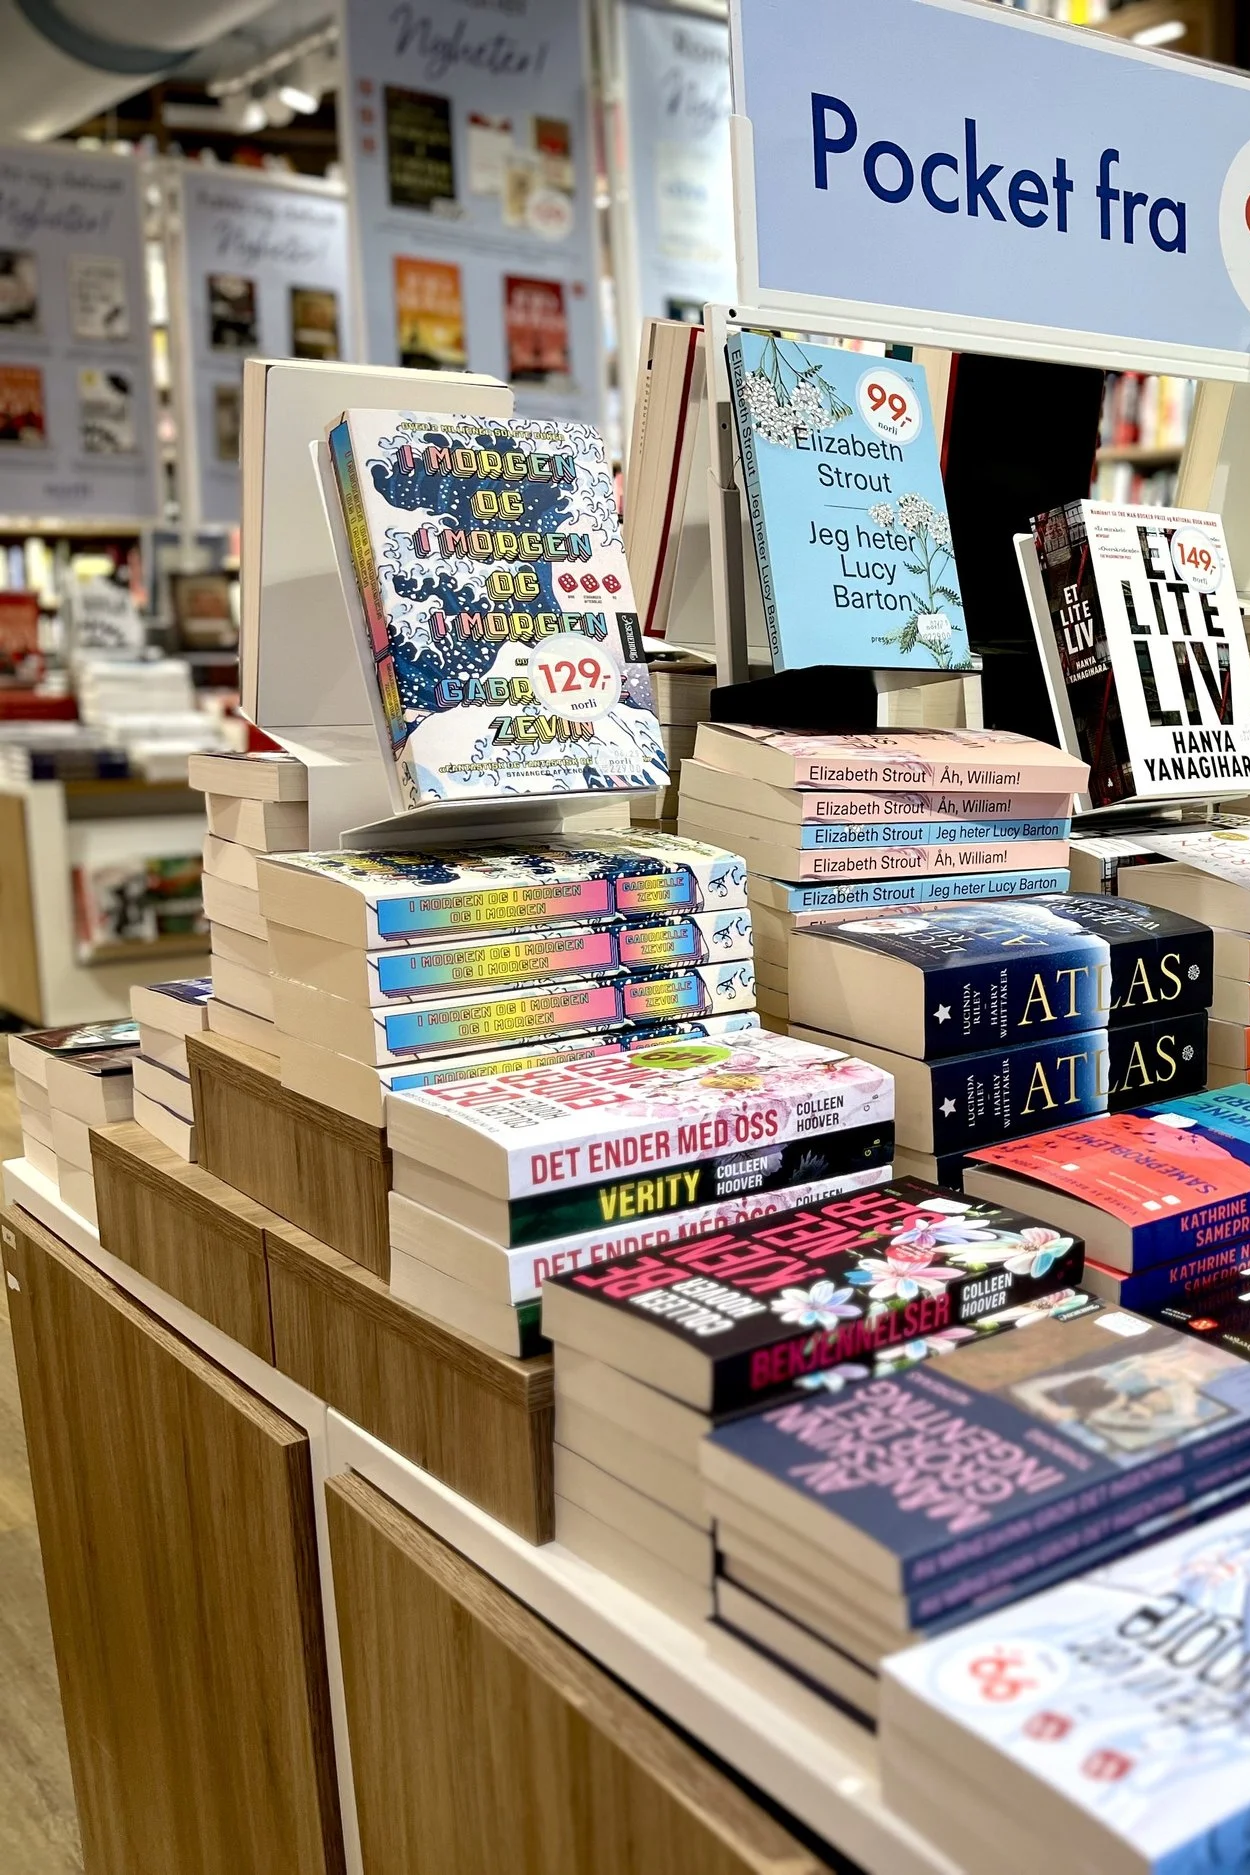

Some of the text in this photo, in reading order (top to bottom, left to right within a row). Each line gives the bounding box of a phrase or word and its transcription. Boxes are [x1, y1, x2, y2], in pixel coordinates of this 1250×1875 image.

[811, 93, 1073, 232] Pocket
[1096, 148, 1187, 254] fra
[868, 384, 912, 428] 99,-
[878, 421, 898, 435] norli
[794, 427, 903, 462] Elizabeth
[398, 445, 576, 483] I MORGEN
[818, 463, 892, 493] Strout
[471, 490, 524, 521] OG
[731, 350, 779, 656] Elizabeth Strout Jeg heter Lucy Barton
[414, 528, 592, 562] I MORGEN
[809, 521, 916, 552] Jeg heter
[841, 555, 896, 585] Lucy
[1177, 543, 1217, 575] 149,-
[486, 571, 540, 601] OG
[1063, 584, 1078, 605] ET
[1192, 576, 1208, 586] norli
[834, 585, 912, 611] Barton
[1121, 580, 1225, 637] LITE
[429, 611, 445, 641] I
[454, 612, 608, 643] MORGEN
[1060, 601, 1091, 627] LITE
[1064, 619, 1093, 655] LIV
[538, 658, 611, 695] 129,-
[1069, 664, 1108, 684] YANAGIHARA
[1076, 656, 1096, 670] HANYA
[1133, 640, 1233, 726] LIV
[571, 698, 597, 712] norli
[489, 715, 595, 746] ZEVIN
[1172, 730, 1236, 754] HANYA
[809, 765, 1021, 786] Elizabeth Strout Åh, William!
[815, 823, 1059, 844] Elizabeth Strout Jeg heter Lucy Barton
[410, 885, 581, 912] I MORGEN OG I MORGEN
[623, 877, 685, 892] GABRIELLE
[638, 889, 670, 902] ZEVIN
[451, 903, 546, 923] OG I MORGEN
[990, 983, 998, 1026] HARRY
[1000, 968, 1009, 1038] WHITTAKER
[1018, 952, 1182, 1027] ATLAS
[963, 983, 971, 1035] LUCINDA
[973, 990, 981, 1025] RILEY
[797, 1094, 844, 1116] COLLEEN
[797, 1112, 839, 1133] HOOVER
[531, 1109, 778, 1185] DET ENDER MED OSS
[717, 1156, 768, 1180] COLLEEN
[599, 1169, 700, 1222] VERITY
[717, 1174, 763, 1196] HOOVER
[1181, 1198, 1247, 1232] KATHRINE
[961, 1272, 1013, 1301] COLLEEN
[961, 1290, 1006, 1319] HOOVER
[750, 1293, 950, 1390] BEKJENNELSER
